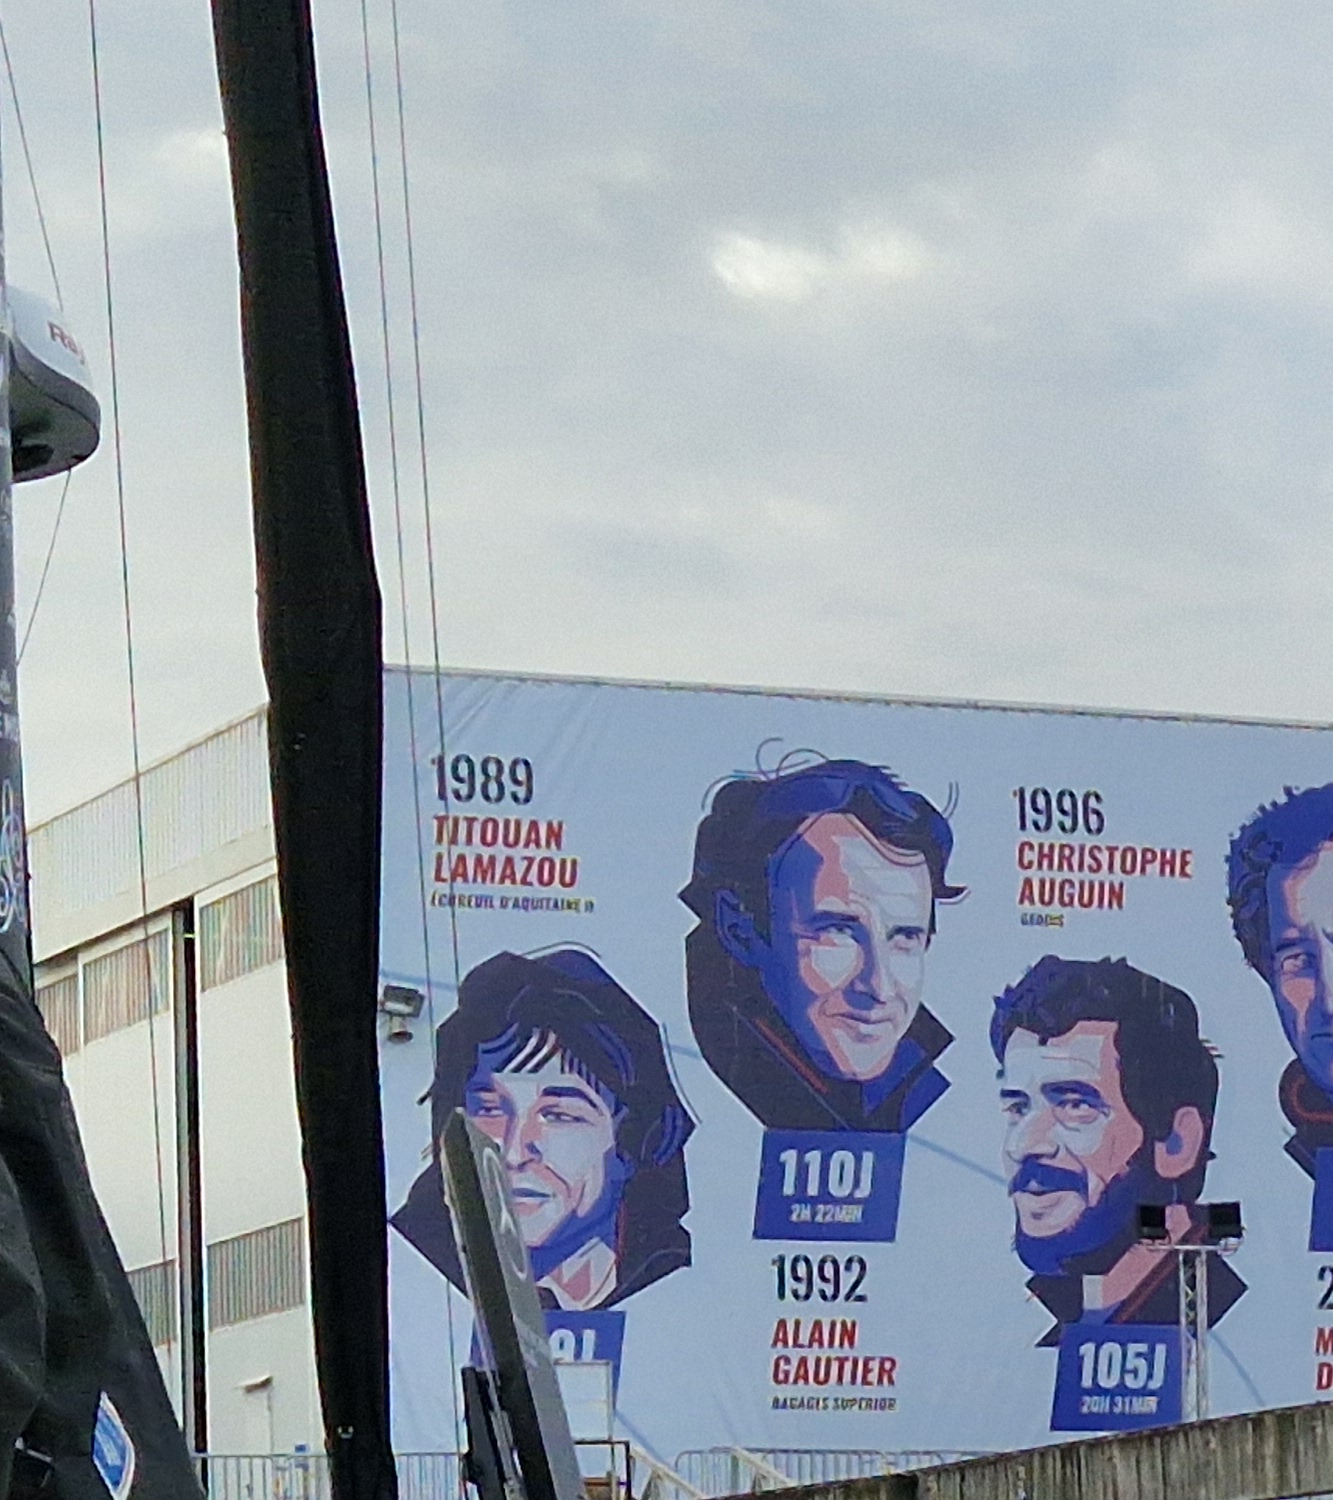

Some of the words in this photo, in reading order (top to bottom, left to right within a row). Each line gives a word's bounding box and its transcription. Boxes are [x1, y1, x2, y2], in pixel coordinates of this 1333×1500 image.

[430, 754, 534, 805] 1989
[1012, 786, 1106, 836] 1996
[434, 815, 564, 850] TITOUAN
[434, 852, 578, 888] LAMAZOU
[1017, 841, 1193, 879] CHRISTOPHE
[1018, 877, 1124, 910] AUGUIN
[779, 1149, 875, 1198] 110J
[771, 1254, 868, 1302] 1992
[771, 1318, 857, 1349] ALAIN
[772, 1354, 897, 1386] GAUTIER
[1080, 1341, 1167, 1390] 105J
